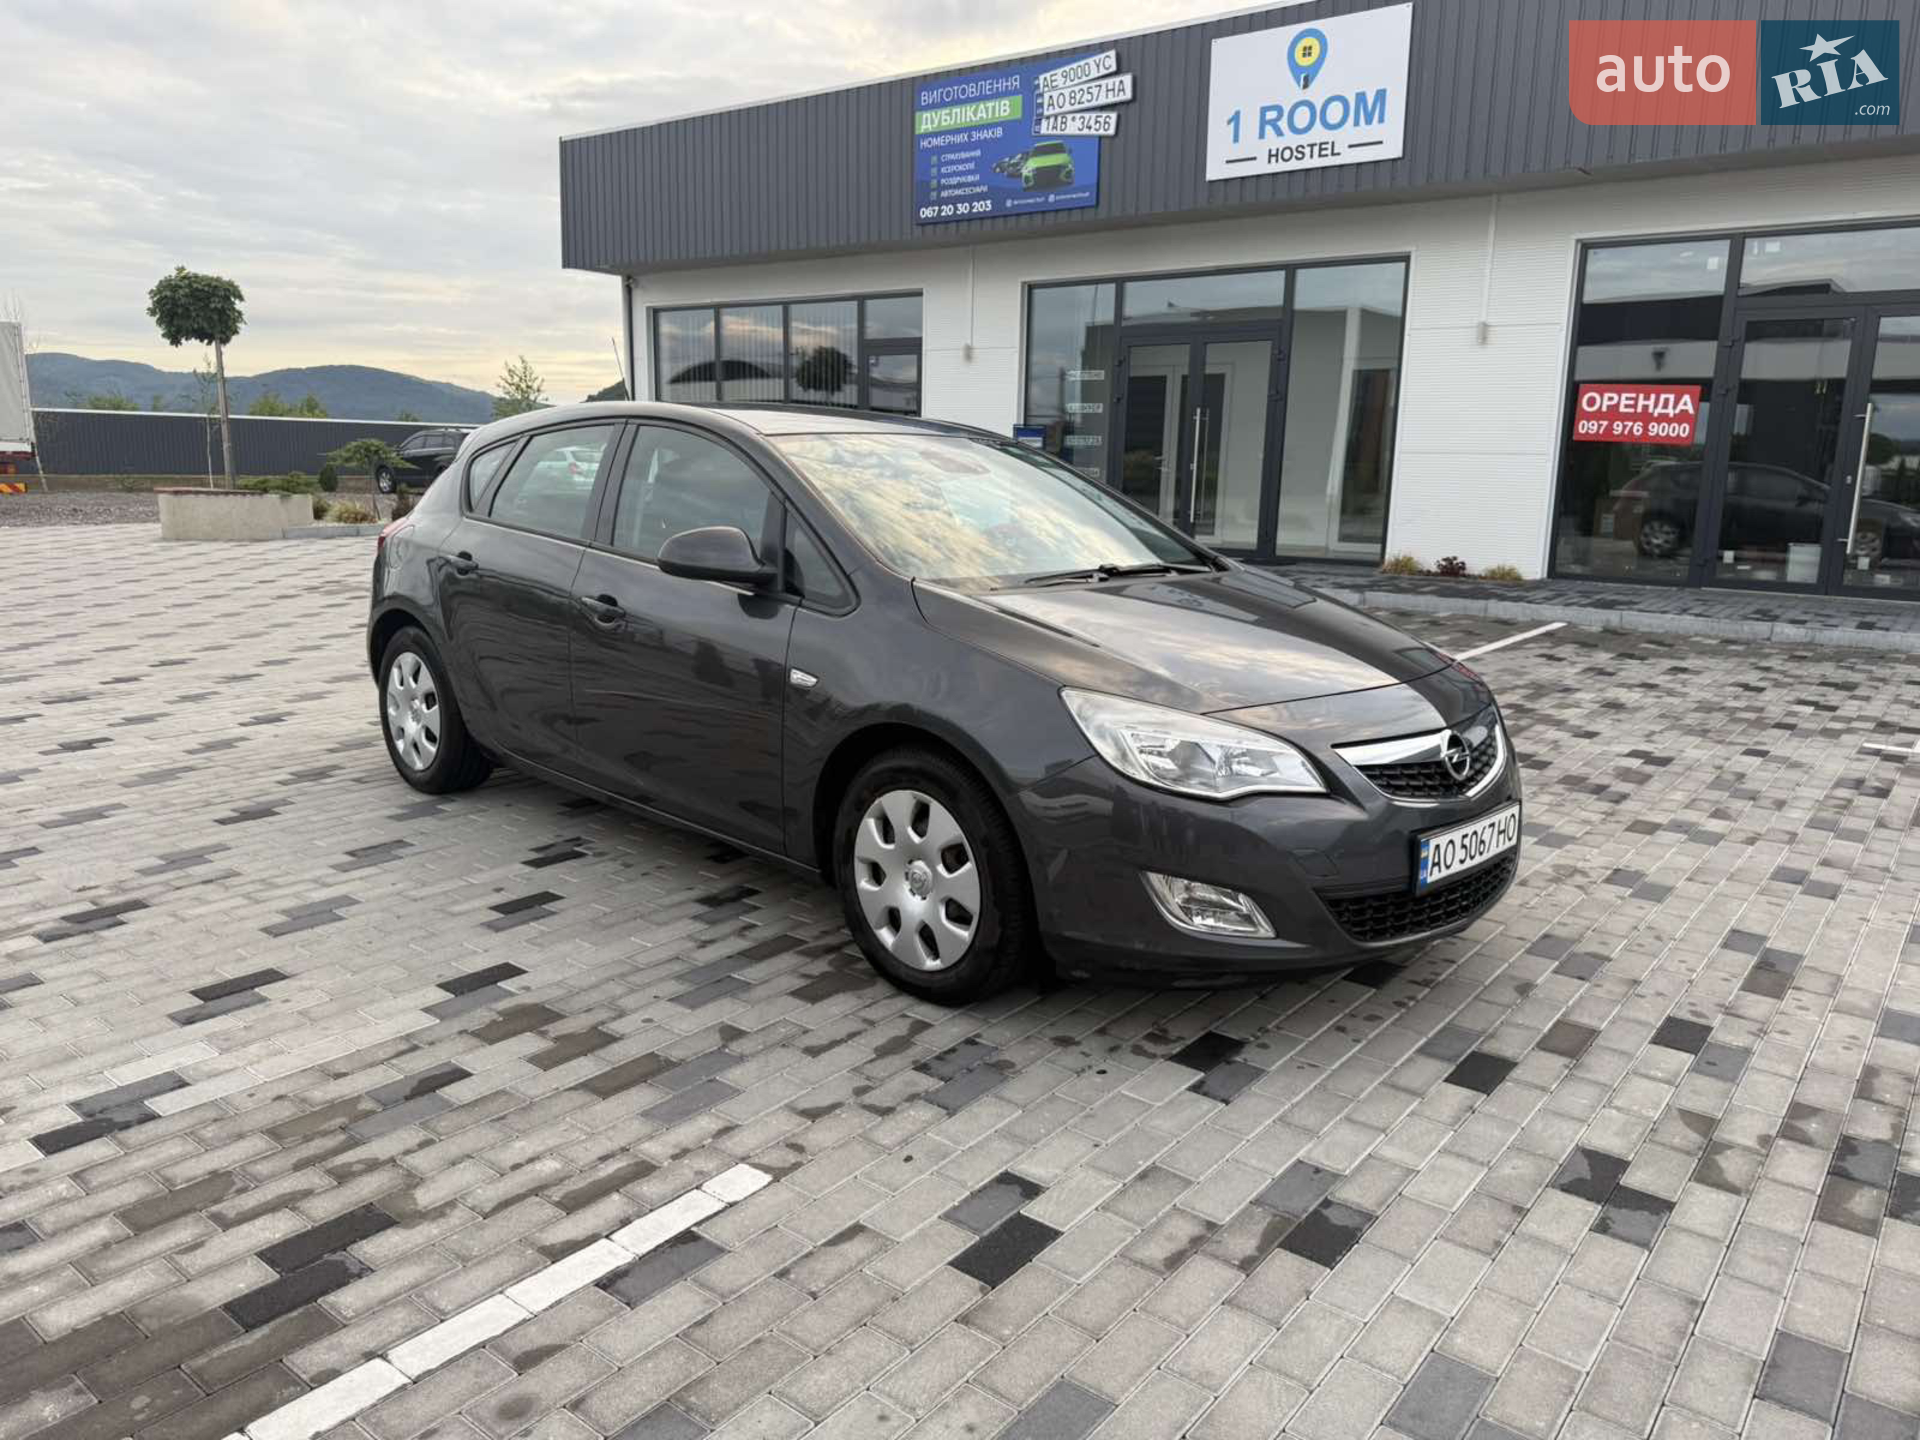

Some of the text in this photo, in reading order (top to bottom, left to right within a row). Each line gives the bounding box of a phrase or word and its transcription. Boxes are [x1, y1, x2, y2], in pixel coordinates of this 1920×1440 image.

[1042, 55, 1112, 91] AE 9000 YC
[921, 75, 1020, 106] ВИГОТОВЛЕННЯ
[1046, 79, 1126, 111] AO 8257 HA
[921, 99, 1010, 133] ДУБЛІКАТІВ
[1077, 115, 1112, 132] 3456
[1226, 88, 1387, 144] 1 ROOM
[920, 126, 1003, 150] НОМЕРНИХ ЗНАКІВ
[1267, 141, 1341, 164] HOSTEL
[920, 199, 992, 218] 067 20 30 203
[1582, 391, 1695, 417] ОРЕНДА
[1578, 420, 1690, 437] 097 976 9000
[1429, 813, 1517, 877] AO 5067 HO
